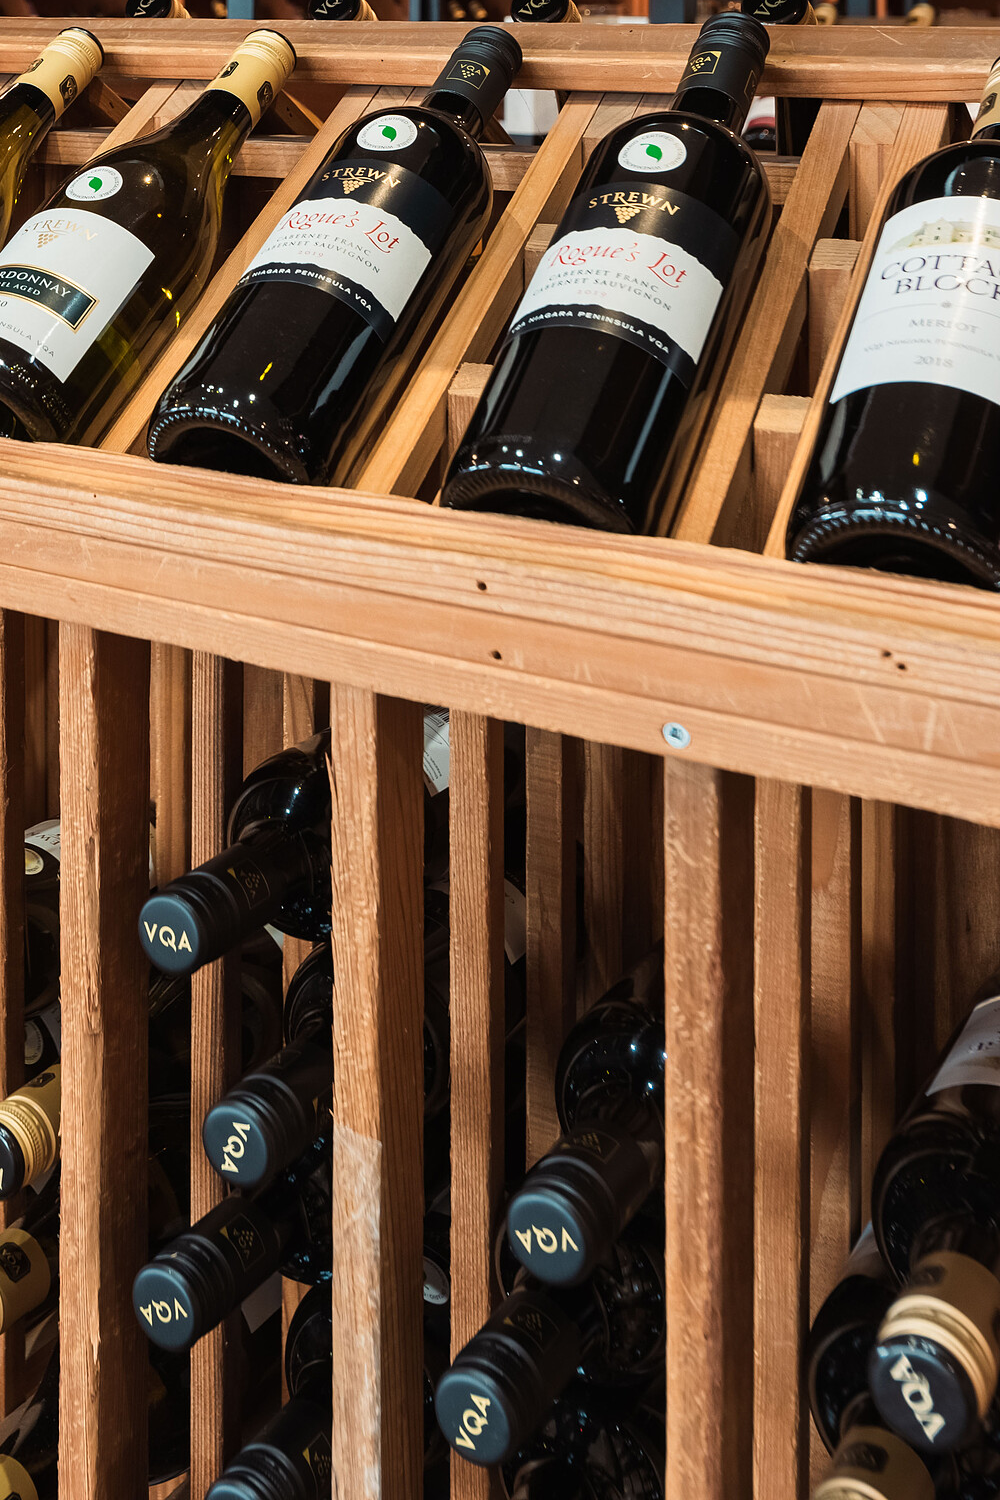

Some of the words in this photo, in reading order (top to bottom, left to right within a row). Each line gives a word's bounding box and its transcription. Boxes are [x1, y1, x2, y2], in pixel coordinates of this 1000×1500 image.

[460, 63, 481, 76] VQA
[690, 56, 712, 67] VQA
[321, 167, 401, 188] STREWN
[588, 191, 681, 216] STREWN
[276, 233, 328, 242] CABERNET
[334, 236, 372, 257] FRANC
[278, 210, 360, 231] Rogue's
[364, 219, 401, 254] Lot
[313, 240, 381, 274] SAUVIGNON
[549, 242, 641, 267] Rogue's
[647, 251, 688, 289] Lot
[881, 254, 1000, 280] COTTA
[13, 284, 41, 296] AGED
[252, 268, 291, 278] NIAGARA
[294, 268, 351, 295] PENINSULA
[354, 293, 372, 312] VQA
[549, 269, 609, 281] CABERNET
[616, 271, 659, 293] FRANC
[593, 278, 672, 311] SAUVIGNON
[528, 311, 574, 323] NIAGARA
[577, 311, 644, 337] PENINSULA
[648, 334, 670, 354] VQA
[909, 318, 979, 334] MERLOT
[143, 921, 193, 953] VQA
[221, 1121, 251, 1173] VQA
[514, 1224, 580, 1255] VQA
[139, 1297, 188, 1326] VQA
[890, 1351, 946, 1443] VQA
[455, 1392, 491, 1451] VQA
